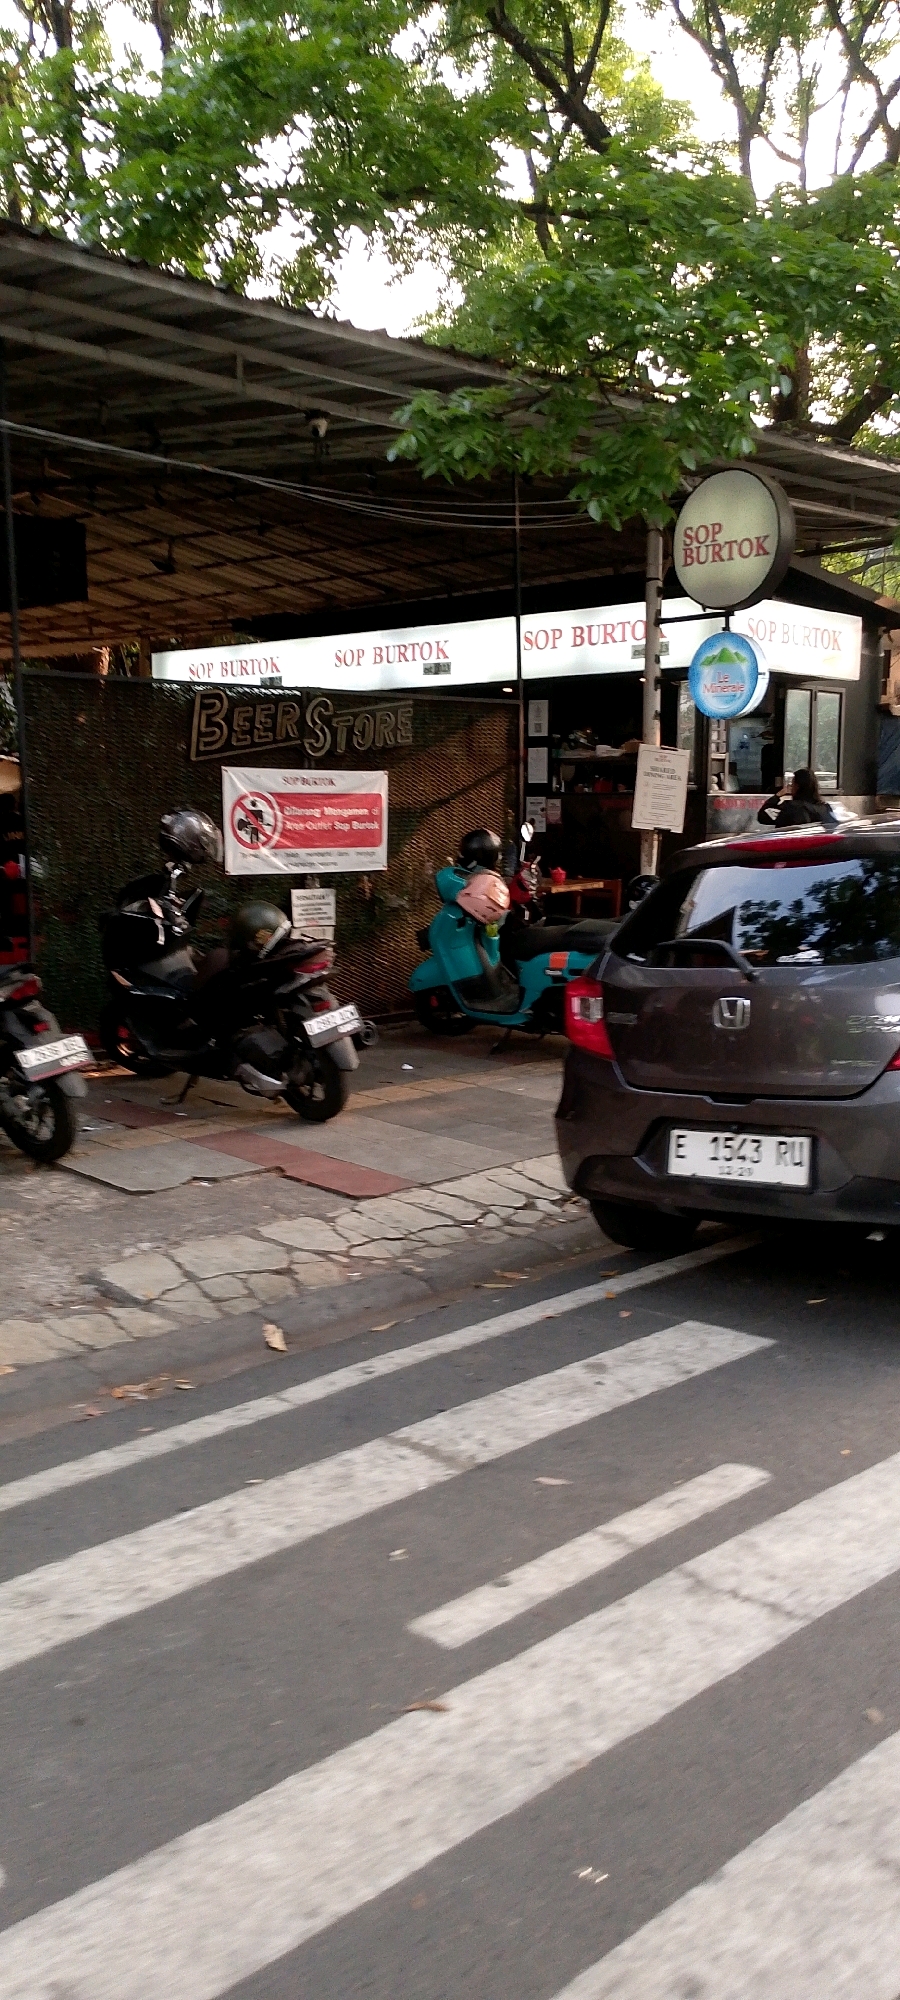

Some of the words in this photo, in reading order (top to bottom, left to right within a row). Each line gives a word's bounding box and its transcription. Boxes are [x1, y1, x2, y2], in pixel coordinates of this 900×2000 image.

[683, 522, 723, 547] SOP
[682, 535, 770, 567] BURTOK
[523, 629, 563, 651] SOP
[748, 617, 778, 643] SOP
[781, 622, 843, 651] BURTOK
[334, 648, 365, 668] SOP
[372, 640, 450, 665] BURTOK
[188, 663, 214, 682] SOP
[219, 656, 281, 678] BURTOK
[716, 671, 730, 683] Le
[702, 681, 745, 694] Minerale
[675, 1134, 688, 1159] E
[708, 1136, 763, 1164] 1543
[775, 1140, 804, 1167] RU
